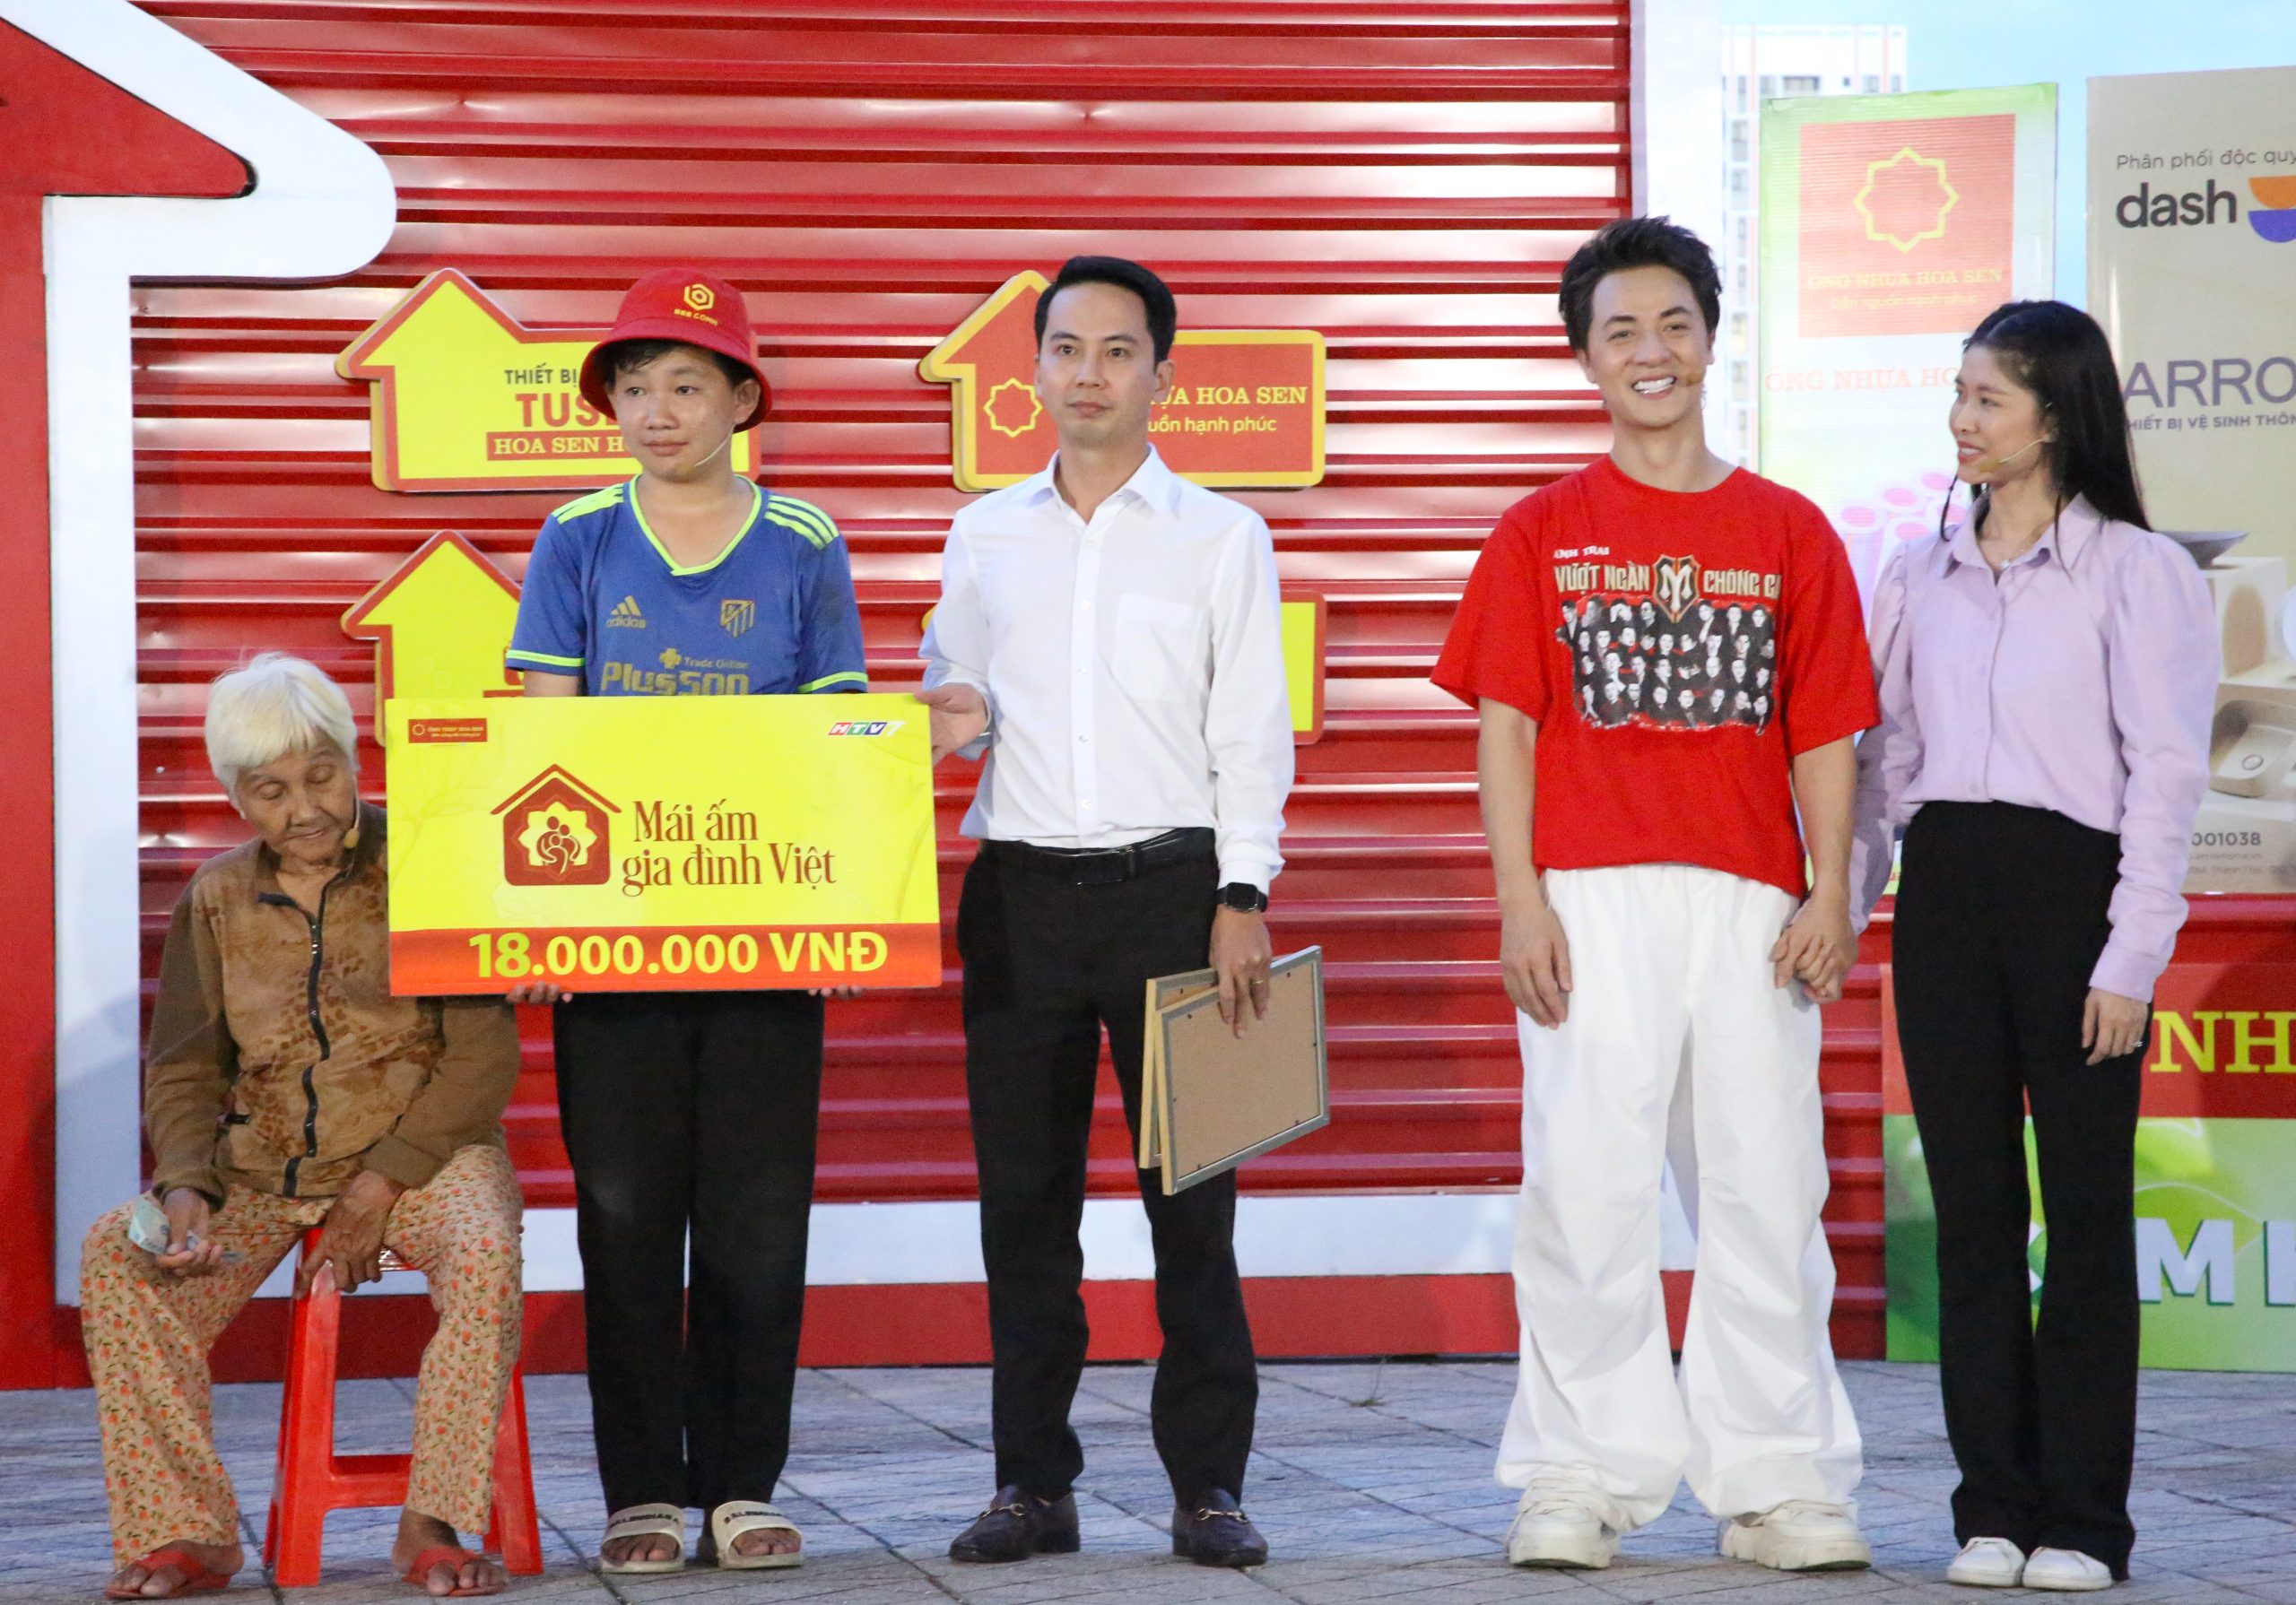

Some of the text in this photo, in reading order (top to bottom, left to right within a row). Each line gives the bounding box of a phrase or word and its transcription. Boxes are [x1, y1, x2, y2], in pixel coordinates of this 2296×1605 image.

[2117, 154, 2163, 169] Phân
[2170, 149, 2213, 169] phối
[2220, 149, 2257, 167] độc
[2116, 179, 2237, 228] dash
[1915, 270, 1959, 285] HOA
[1964, 267, 2003, 283] SEN
[504, 363, 577, 387] THIẾT BỊ
[1196, 387, 1250, 404] HOA
[1257, 386, 1307, 403] SEN
[516, 393, 617, 427] TUS
[1185, 417, 1229, 435] hạnh
[1233, 416, 1277, 434] phúc
[2127, 414, 2162, 430] HIẾT
[2168, 419, 2181, 431] BỊ
[2187, 414, 2208, 430] VỆ
[2213, 415, 2250, 428] SINH
[494, 438, 545, 455] HOA
[552, 437, 601, 453] SEN
[1604, 560, 1650, 591] NGÀN
[605, 616, 647, 629] adidas
[632, 798, 759, 842] Mái ấm
[622, 843, 837, 897] gia đình Việt
[468, 931, 889, 977] 18.000.000 VNĐ
